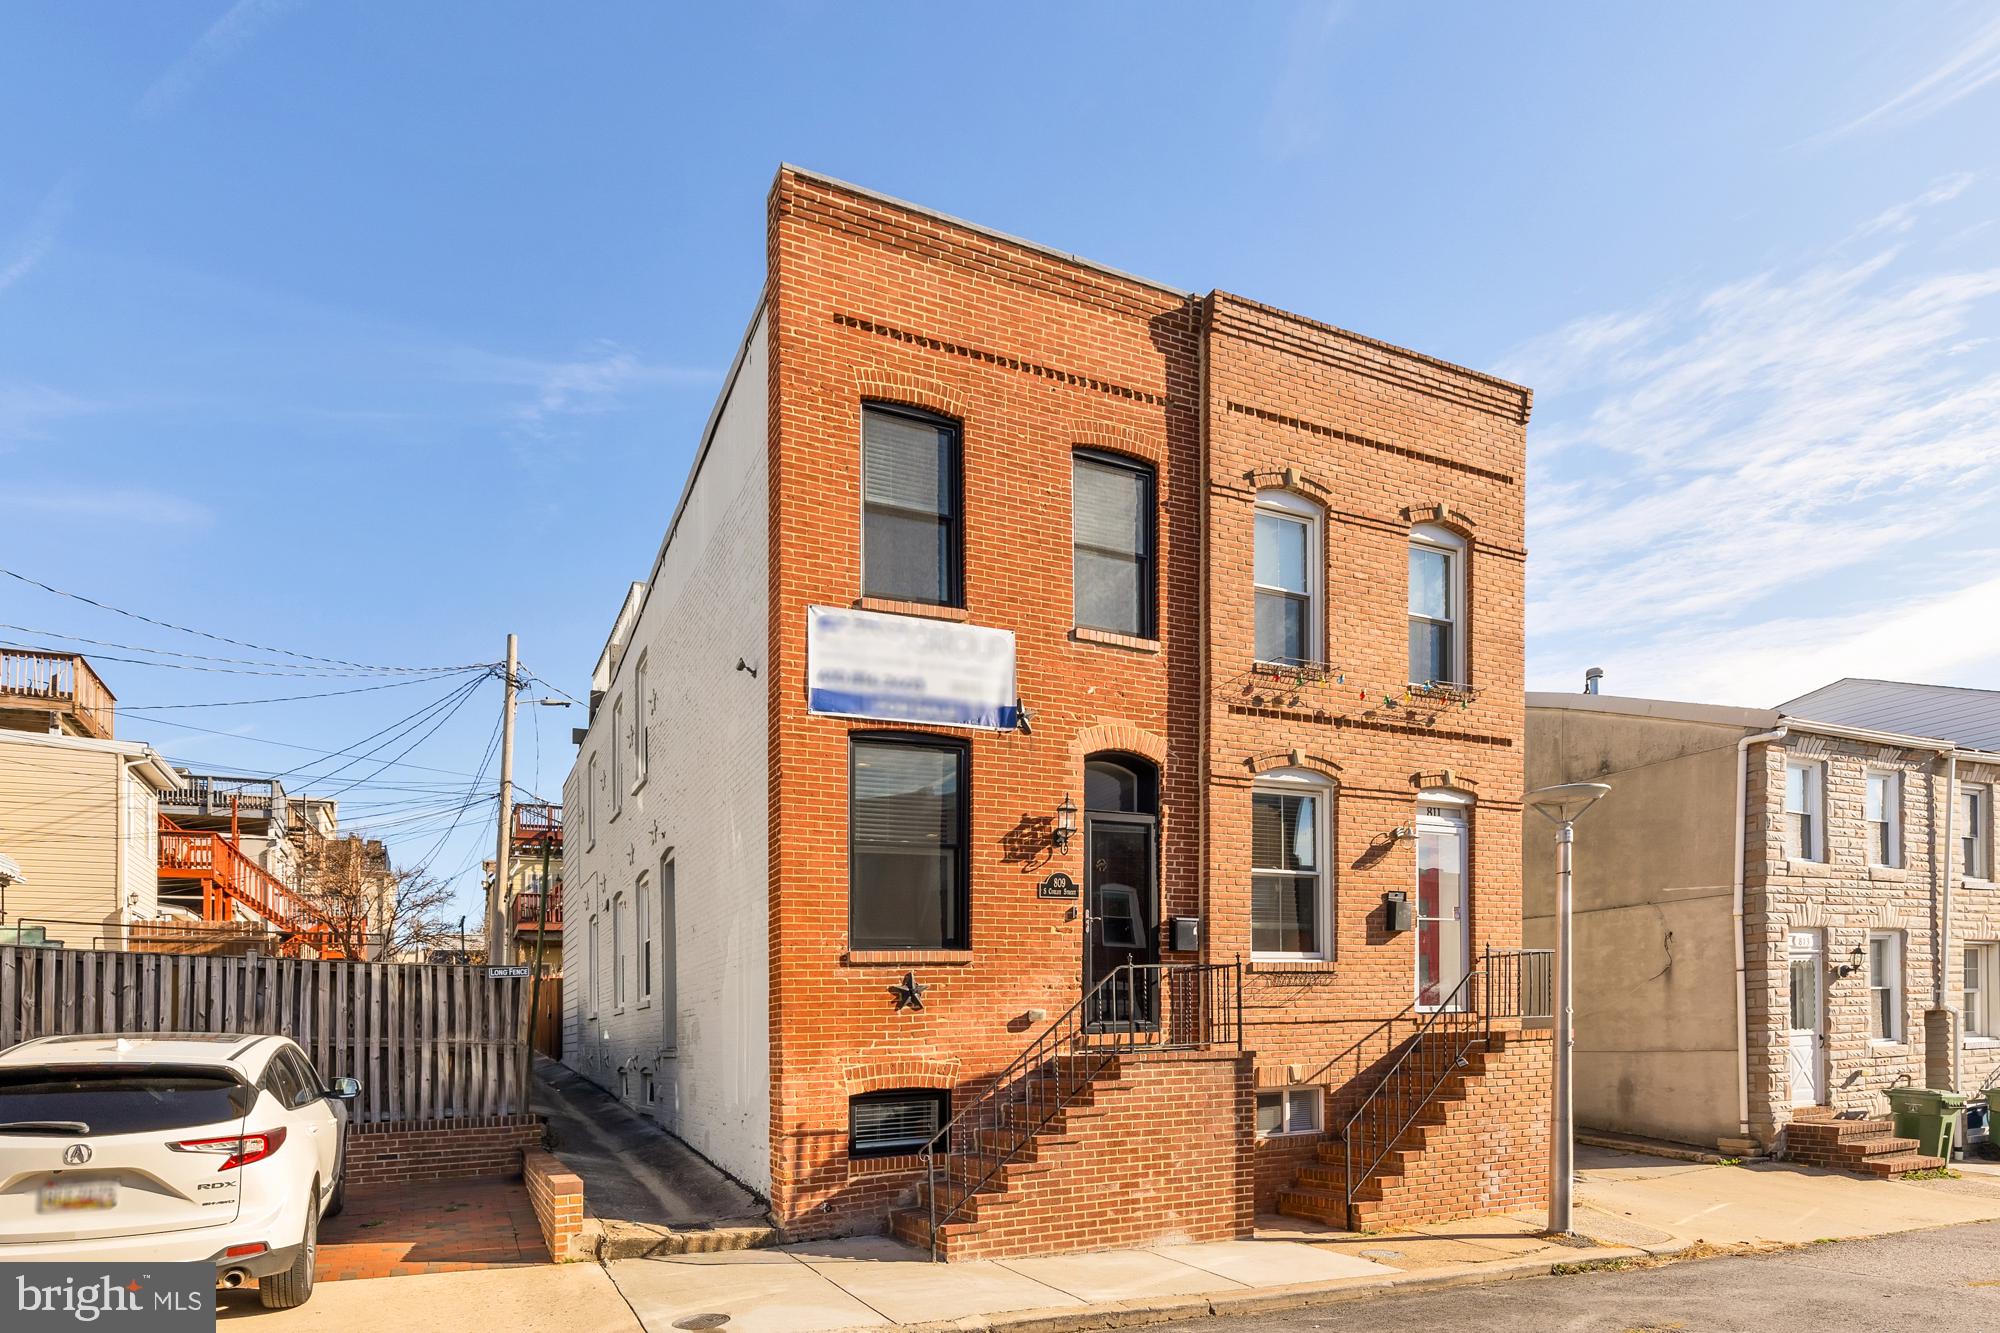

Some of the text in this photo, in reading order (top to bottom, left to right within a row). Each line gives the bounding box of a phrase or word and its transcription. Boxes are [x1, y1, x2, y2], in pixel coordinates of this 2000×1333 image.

[1426, 806, 1441, 817] 811
[1053, 877, 1066, 888] 809
[490, 967, 528, 976] LONG FENCE
[197, 1180, 237, 1191] RDX
